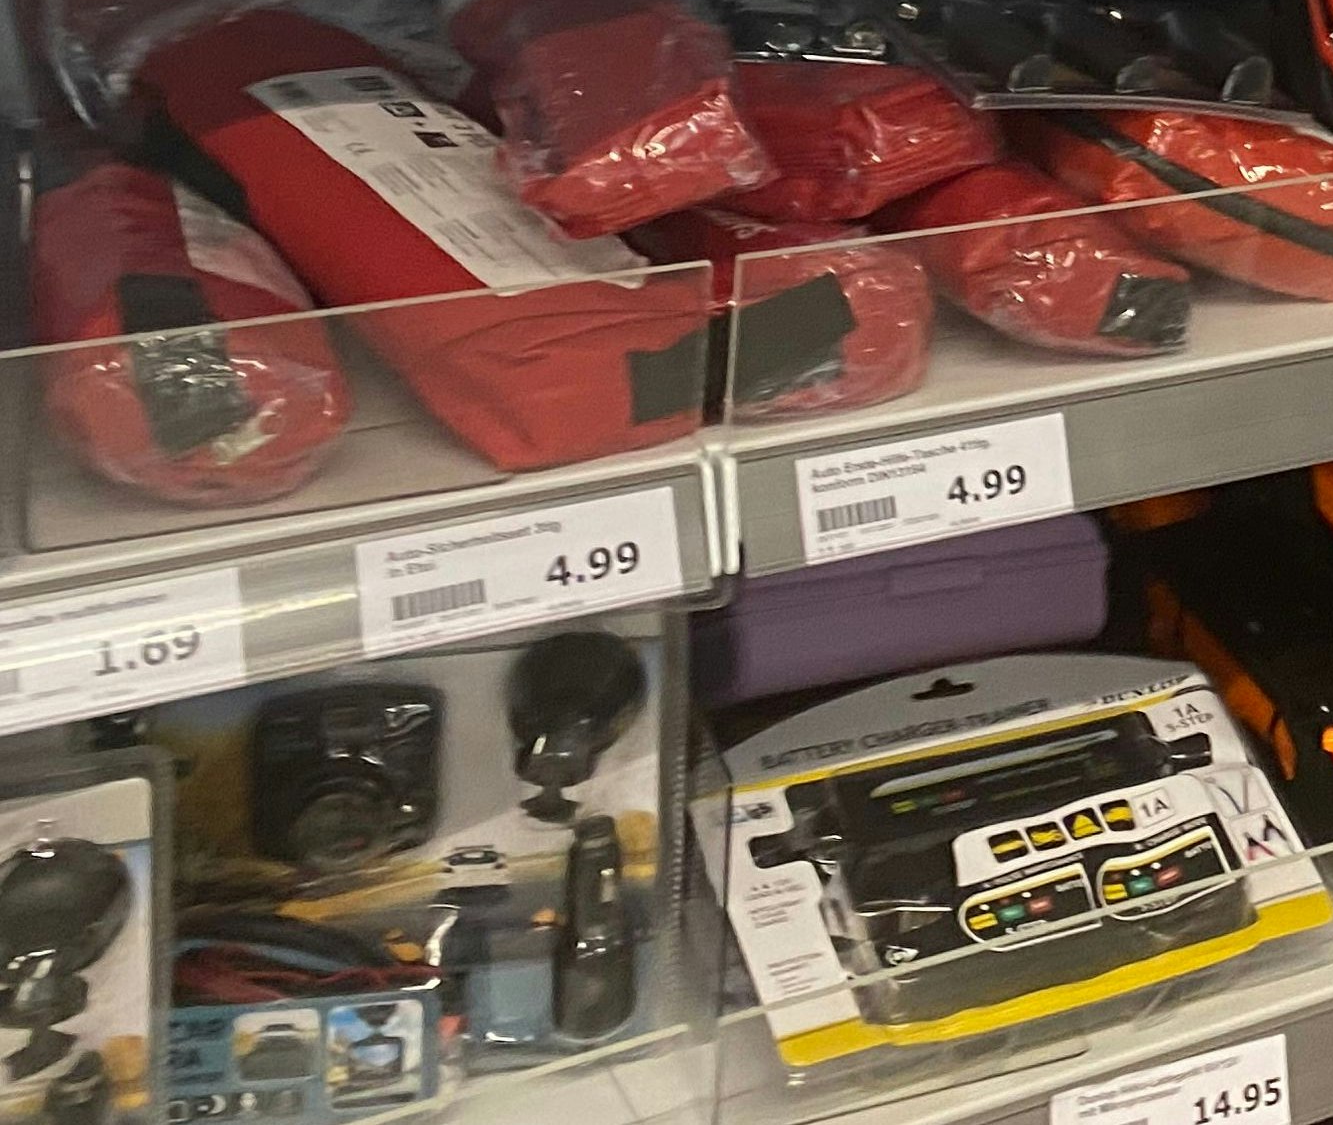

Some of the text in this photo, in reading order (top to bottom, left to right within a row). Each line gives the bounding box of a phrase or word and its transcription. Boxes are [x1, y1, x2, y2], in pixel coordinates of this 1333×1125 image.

[947, 464, 1027, 505] 4.99
[546, 541, 640, 586] 4.99
[94, 623, 202, 677] 1.69
[1172, 703, 1201, 718] 1A
[1193, 1076, 1281, 1125] 14.95
